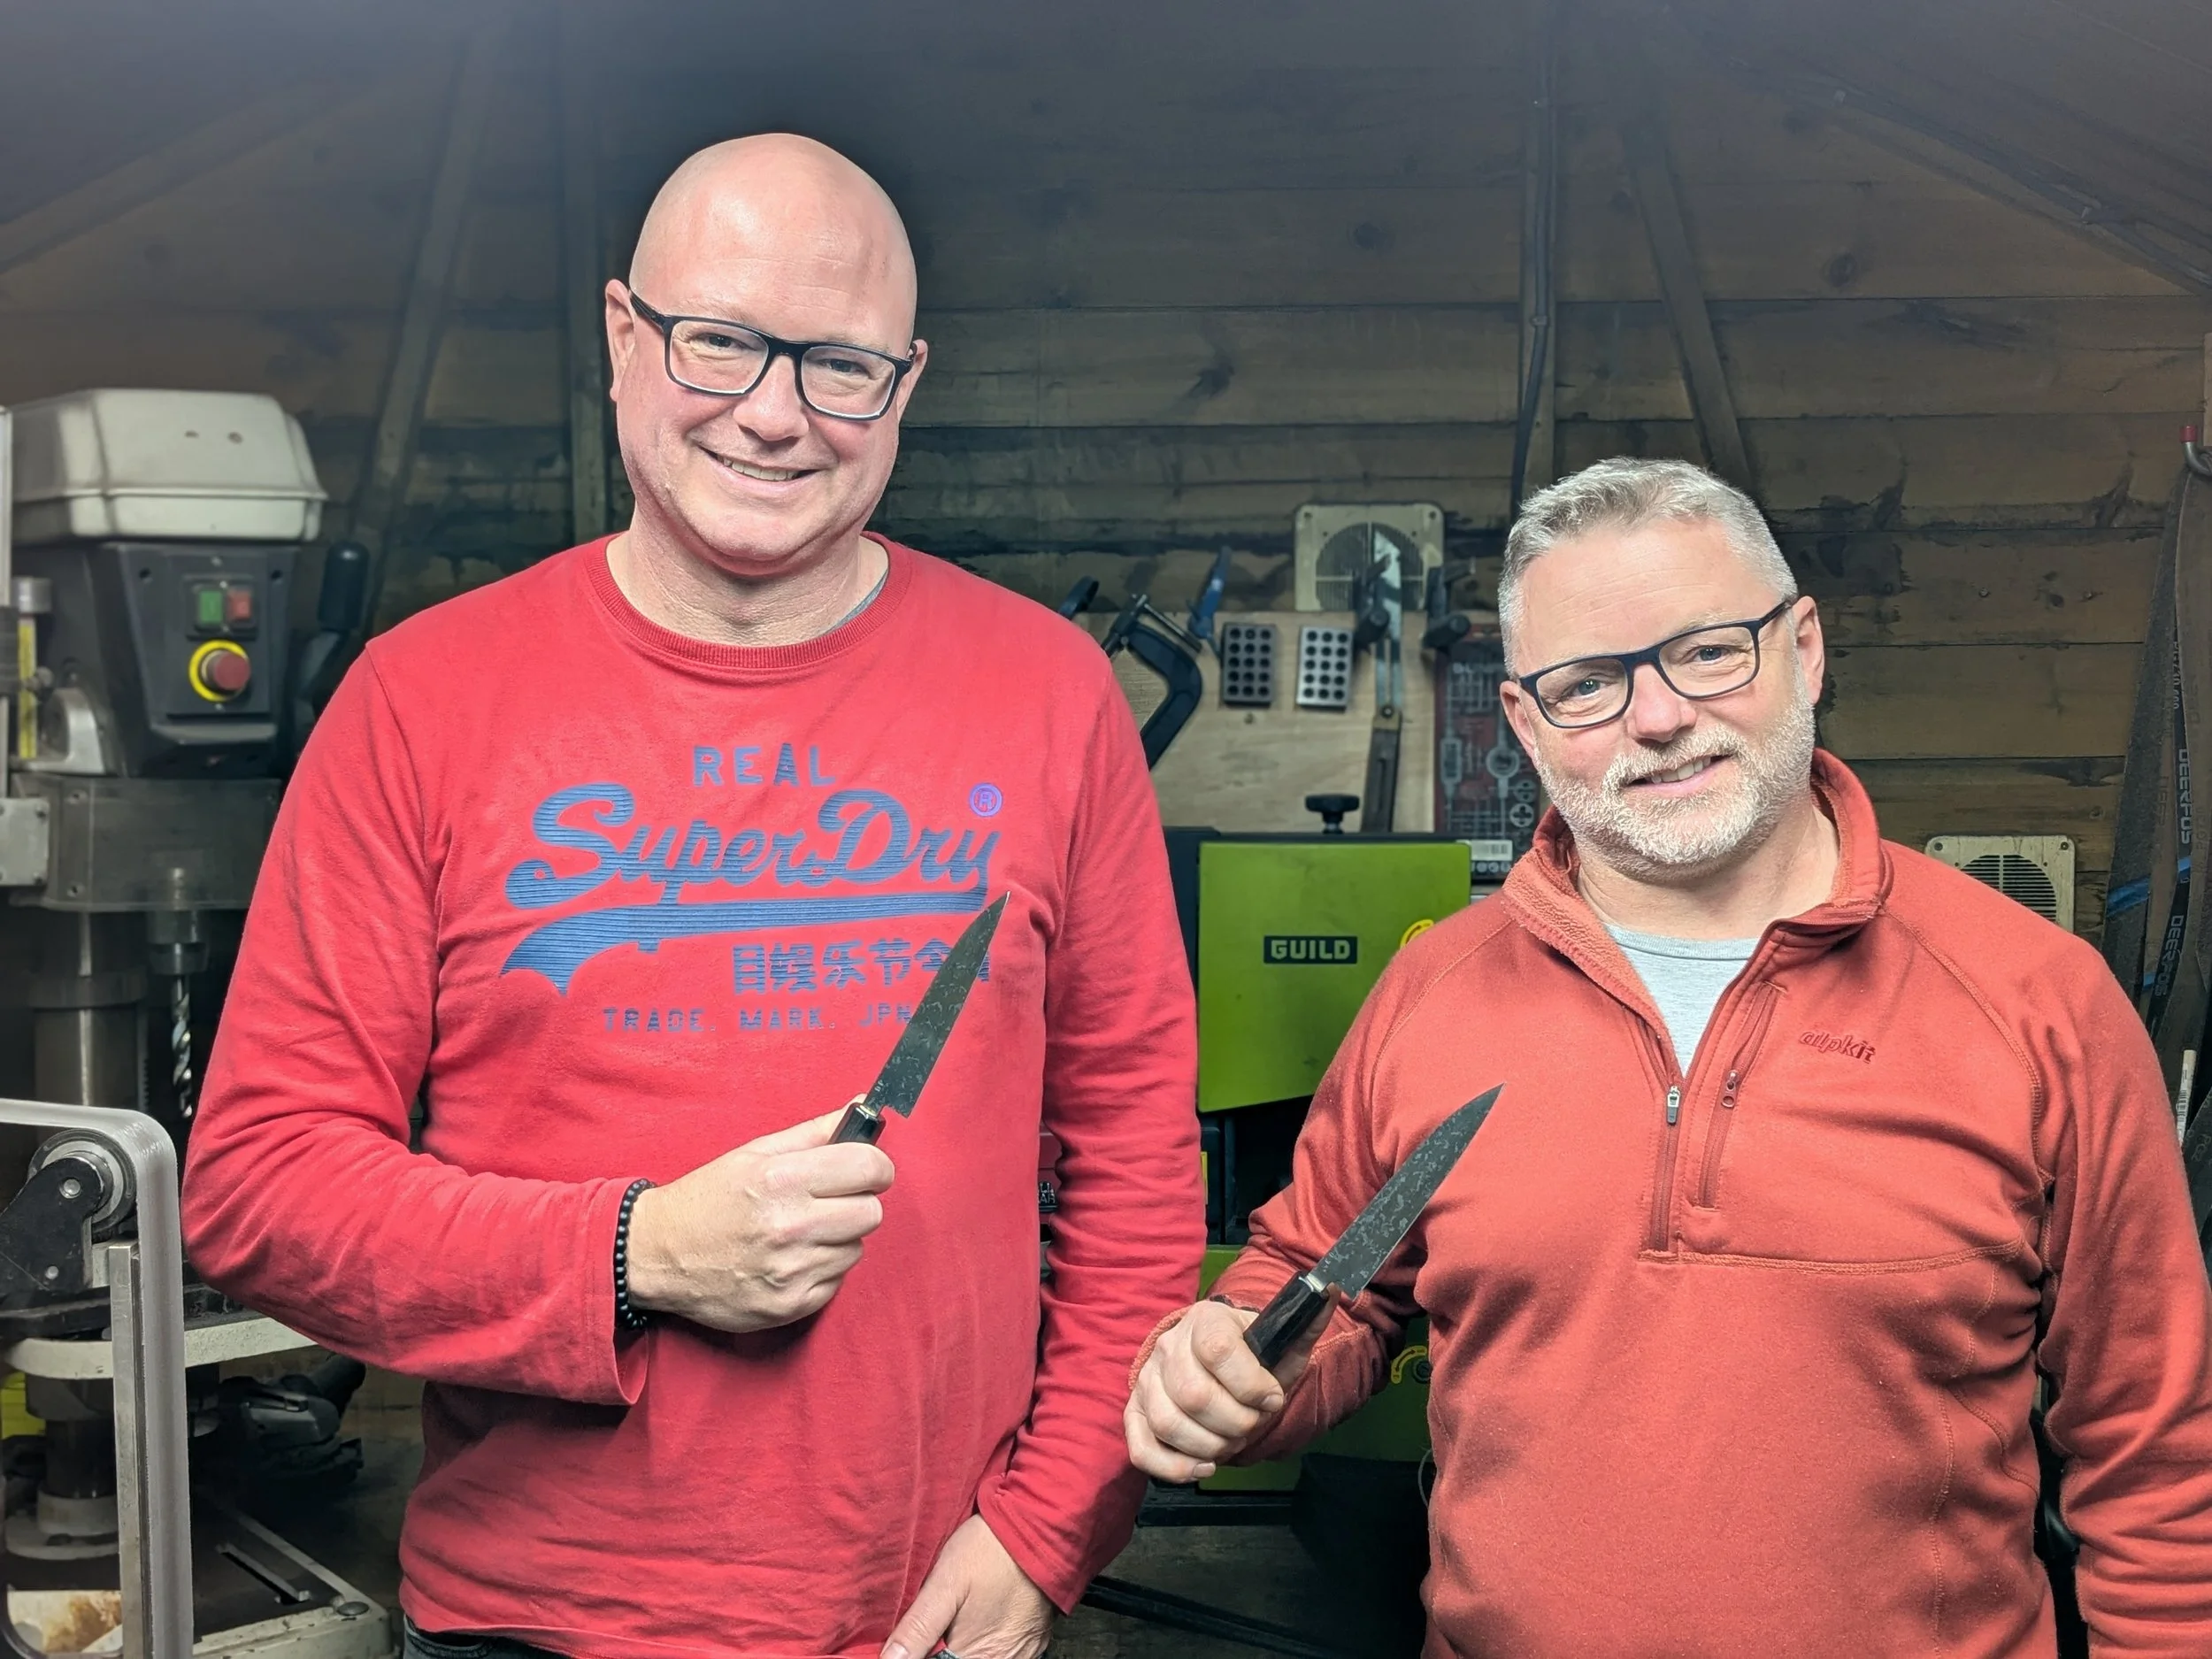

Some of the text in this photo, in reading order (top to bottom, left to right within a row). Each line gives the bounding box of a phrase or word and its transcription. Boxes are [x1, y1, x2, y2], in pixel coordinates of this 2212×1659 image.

[693, 742, 836, 787] REAL
[2178, 748, 2192, 845] DEERFOS
[1270, 939, 1351, 961] GUILD
[2154, 915, 2185, 997] DEERFOS
[1798, 1030, 1877, 1064] alpkit
